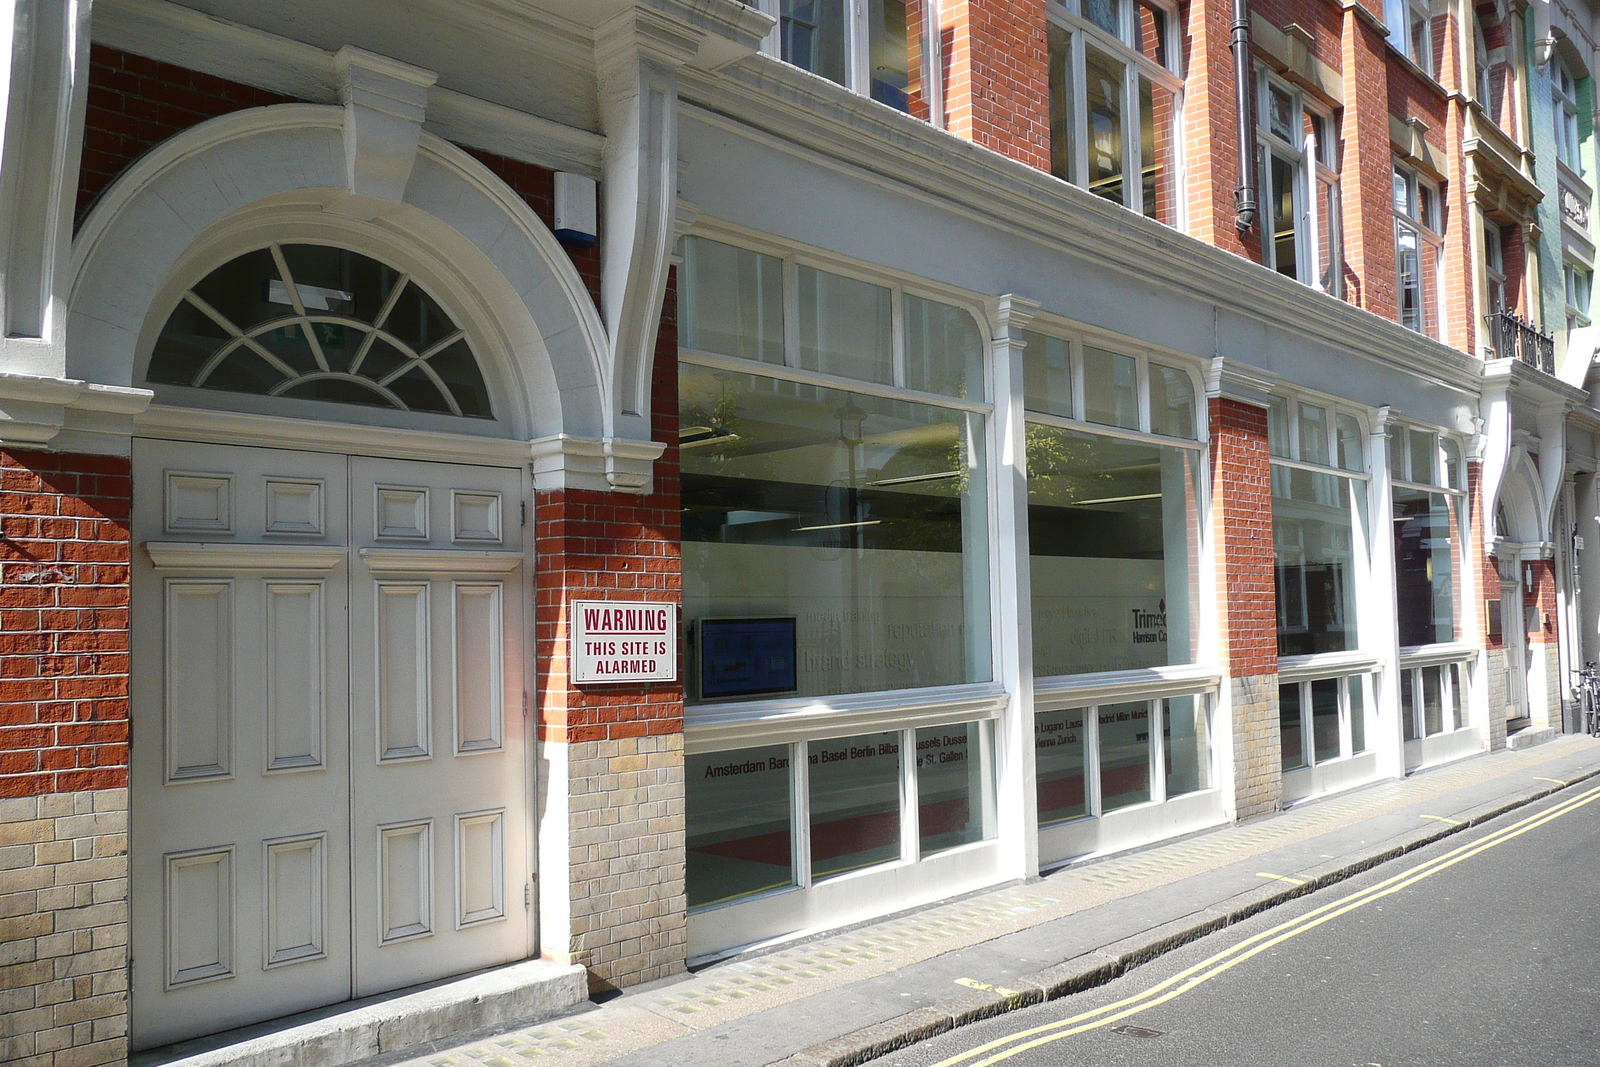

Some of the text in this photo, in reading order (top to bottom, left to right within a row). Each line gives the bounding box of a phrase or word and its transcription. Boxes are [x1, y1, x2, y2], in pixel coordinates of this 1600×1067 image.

[584, 608, 667, 631] WARNING
[585, 641, 666, 656] THIS SITE IS
[596, 659, 656, 674] ALARMED
[705, 760, 765, 778] Amsterdam
[822, 748, 847, 763] Basel
[851, 745, 875, 759] Berlin
[878, 743, 899, 755] Bilba
[916, 737, 940, 750] ussels
[943, 734, 967, 746] Dusse
[1041, 722, 1064, 734] Lugano
[939, 751, 963, 763] Gallen
[1057, 733, 1077, 745] Zurich
